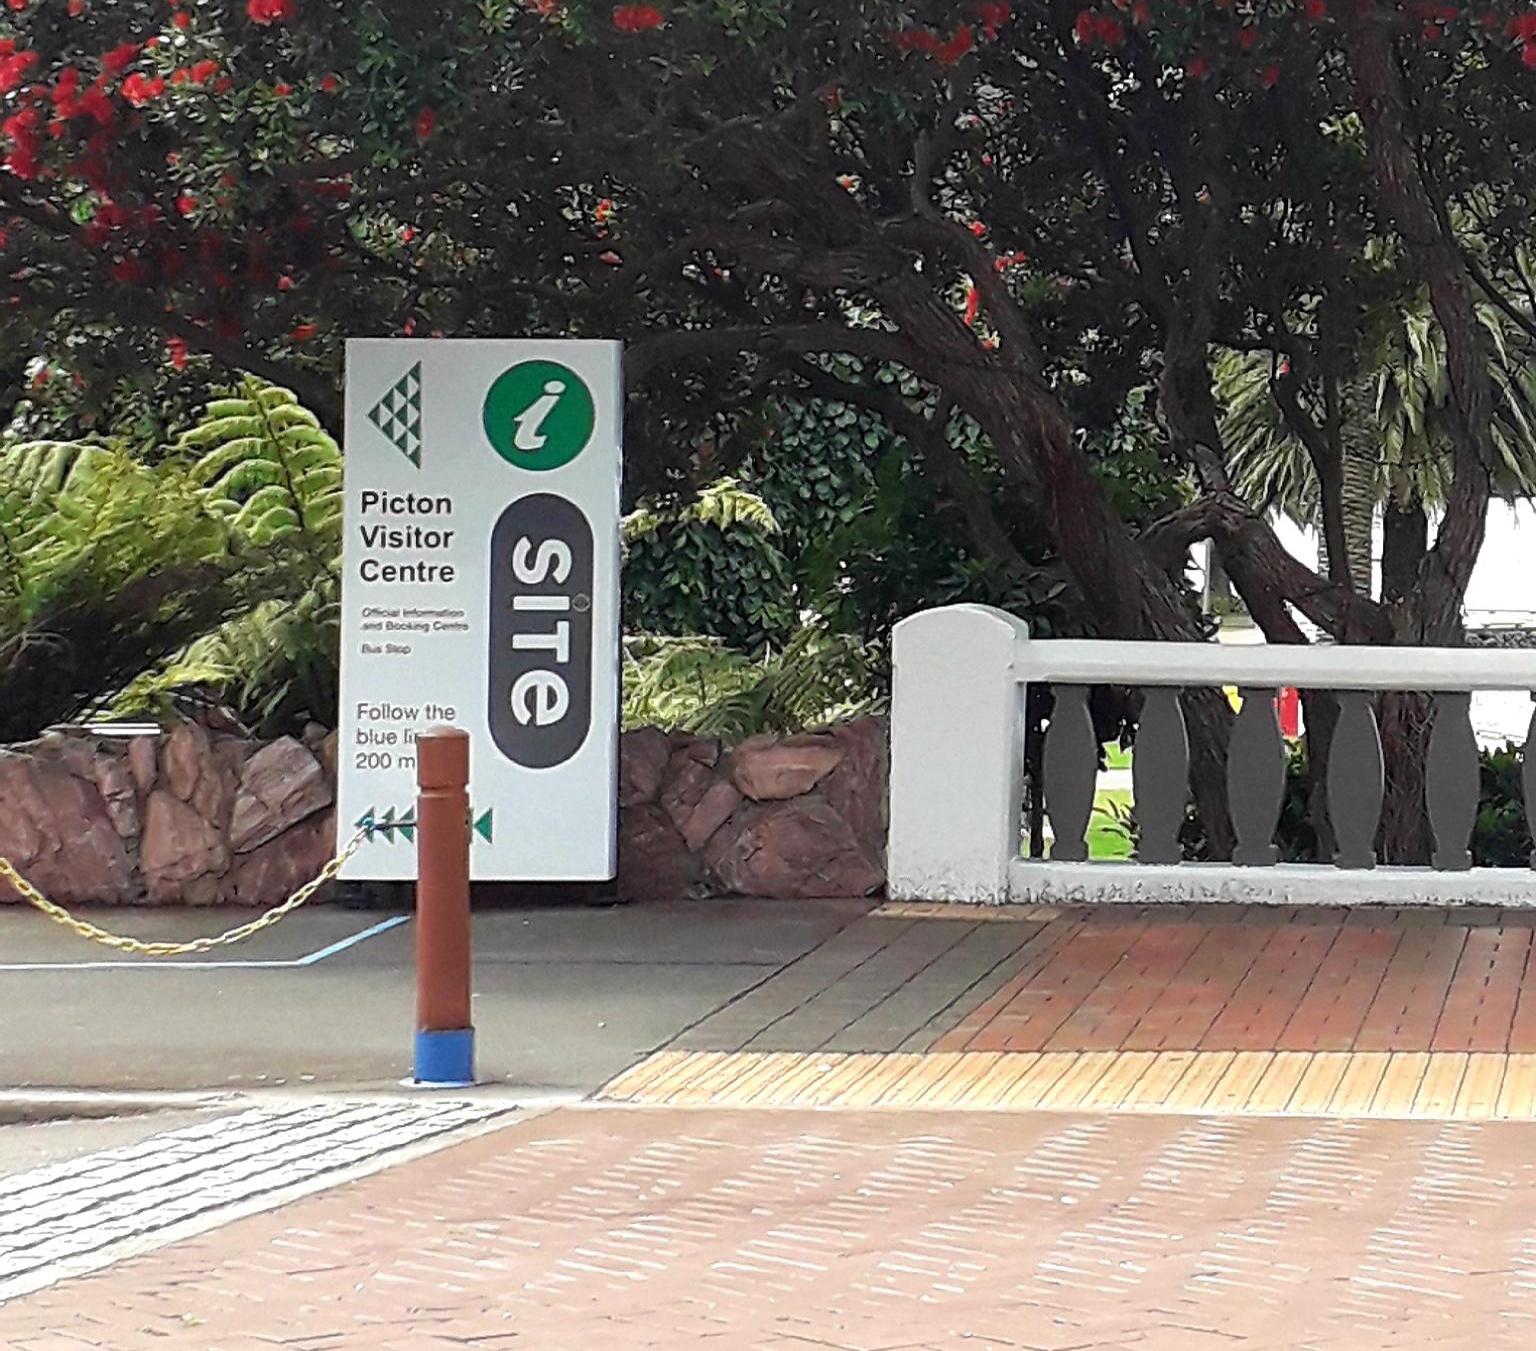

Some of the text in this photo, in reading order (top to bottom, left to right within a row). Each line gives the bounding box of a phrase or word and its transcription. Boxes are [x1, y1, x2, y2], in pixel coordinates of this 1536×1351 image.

[361, 491, 452, 514] Picton
[360, 525, 454, 548] Visitor
[360, 559, 455, 582] Centre
[385, 621, 430, 633] Booking
[357, 703, 456, 721] Follow the
[357, 728, 398, 745] blue
[356, 752, 392, 769] 200
